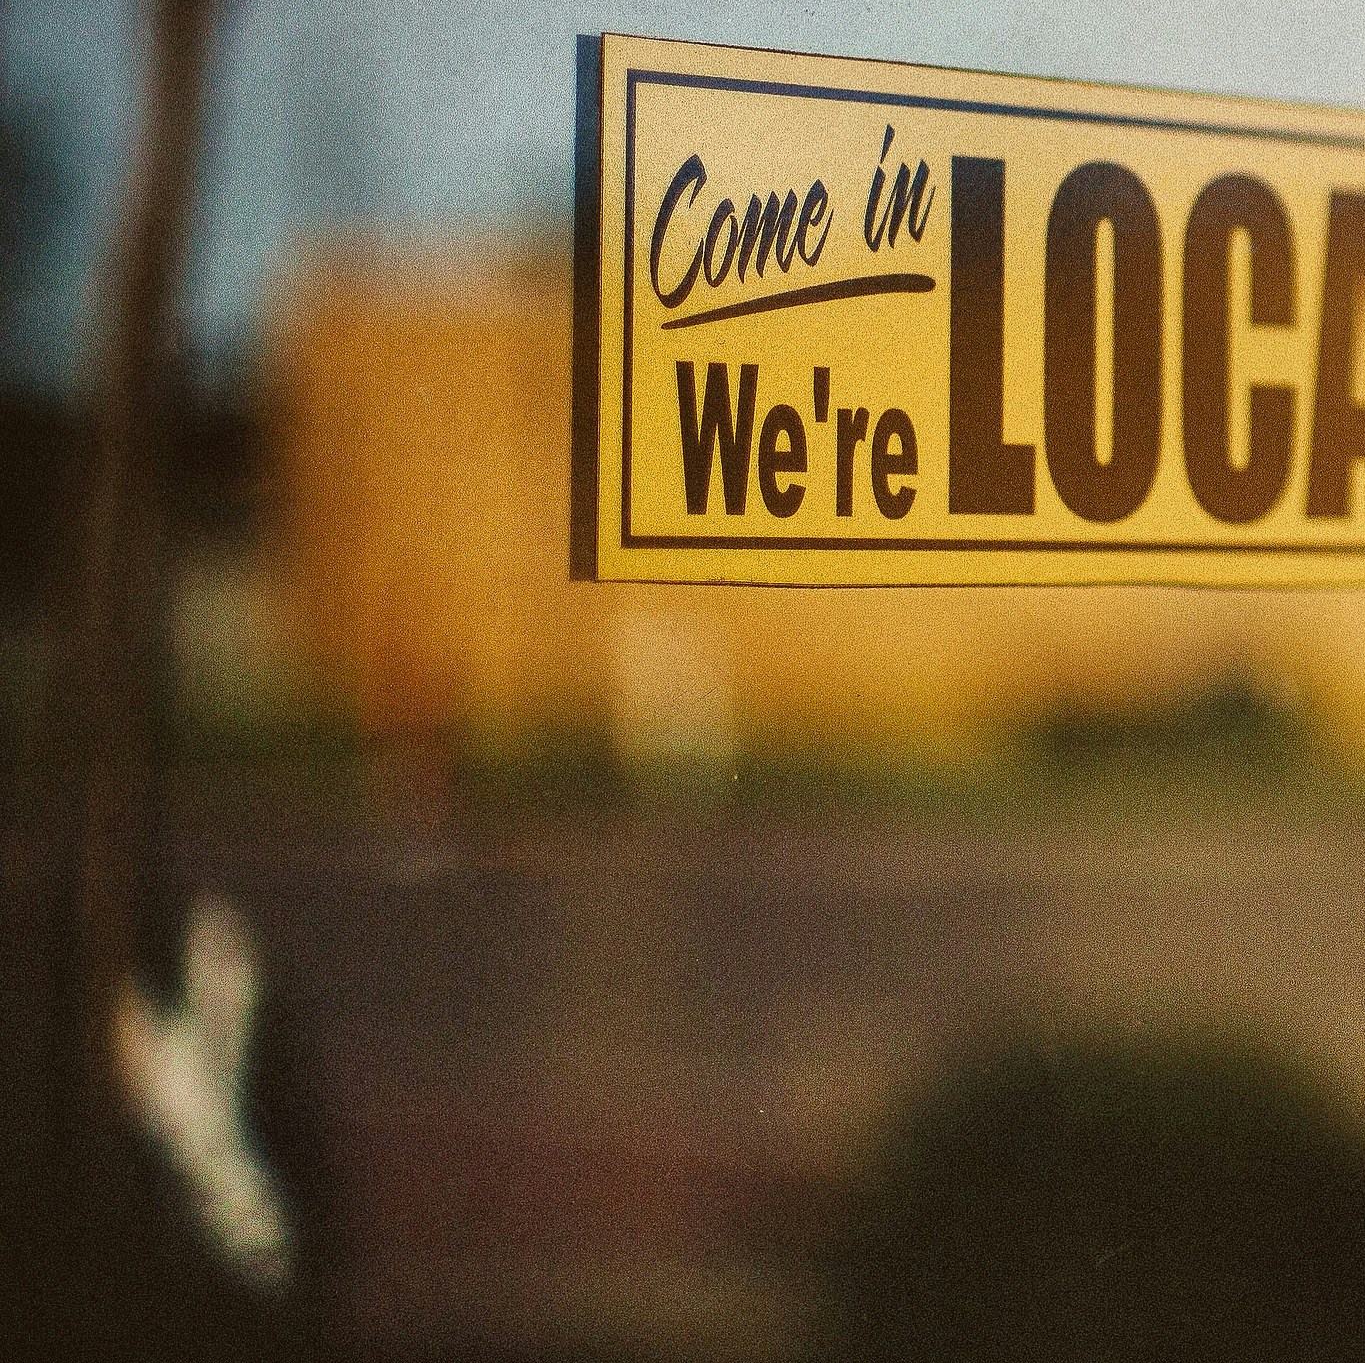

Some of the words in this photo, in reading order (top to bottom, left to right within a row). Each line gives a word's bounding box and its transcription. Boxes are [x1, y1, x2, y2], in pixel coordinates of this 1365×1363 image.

[649, 153, 833, 309] Come
[864, 123, 936, 253] in
[675, 360, 918, 520] We're
